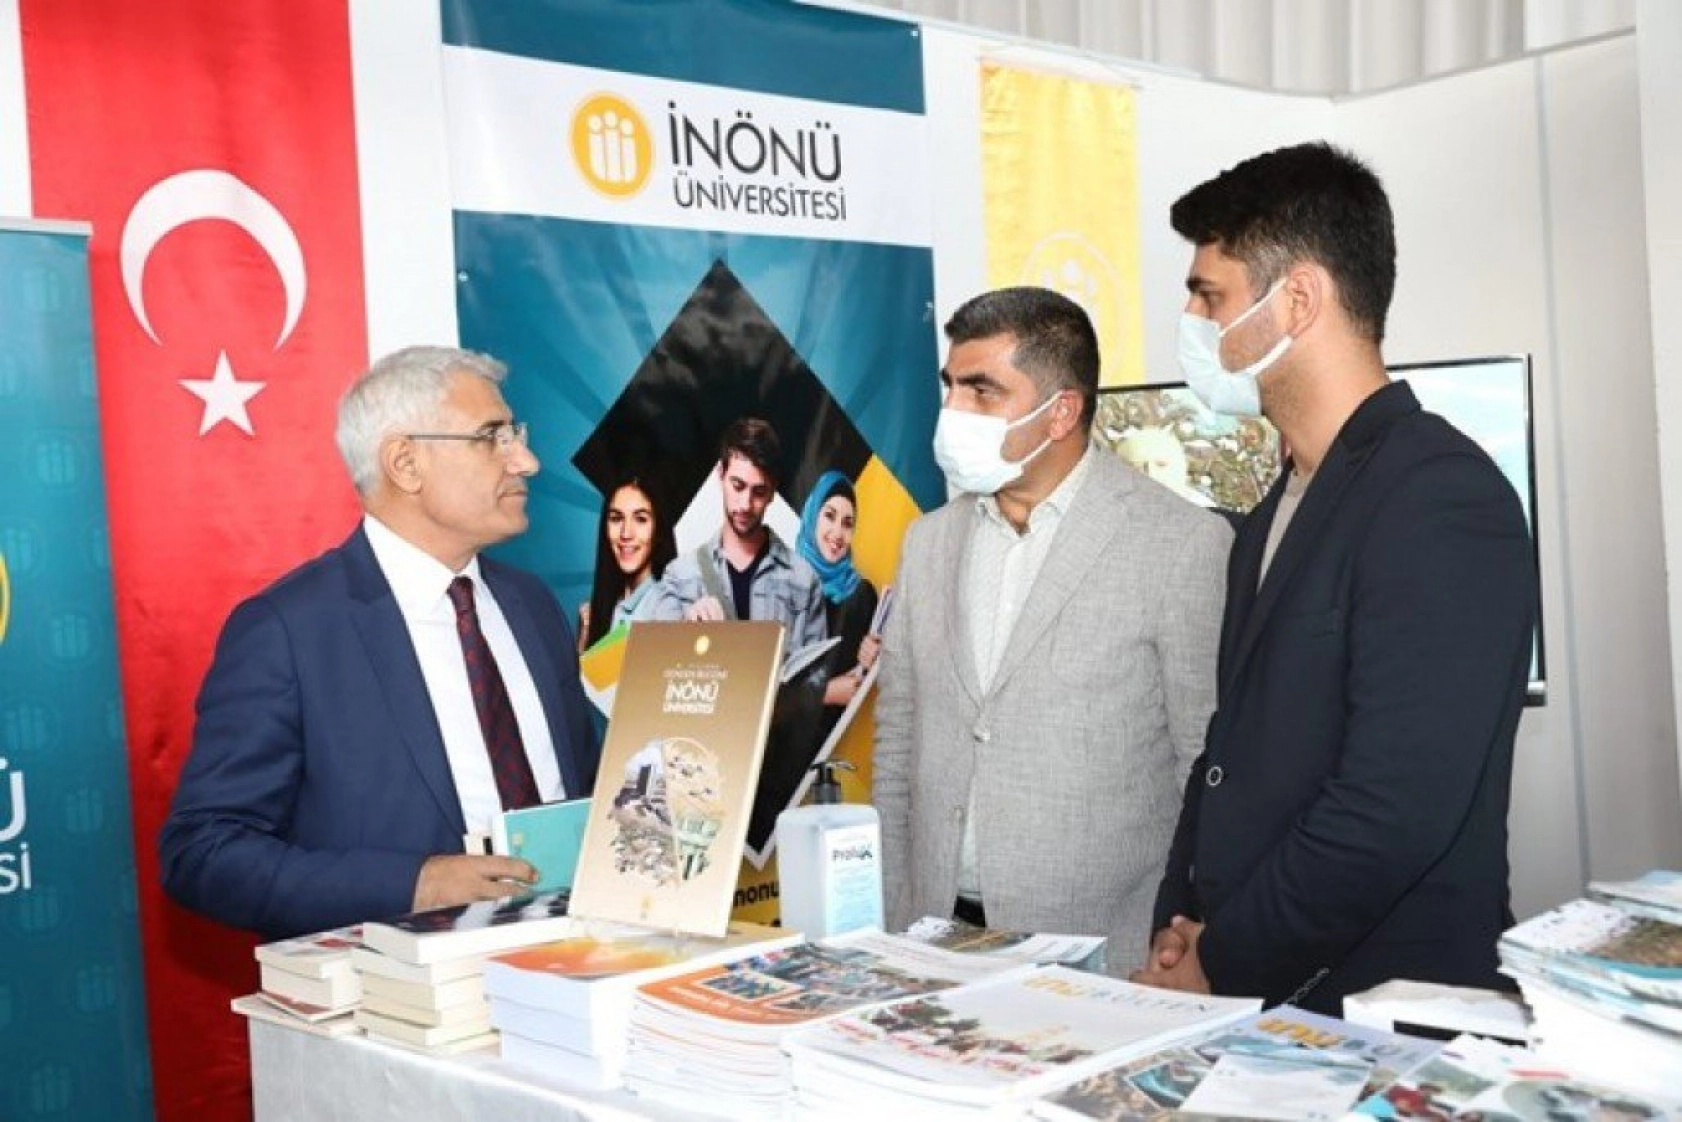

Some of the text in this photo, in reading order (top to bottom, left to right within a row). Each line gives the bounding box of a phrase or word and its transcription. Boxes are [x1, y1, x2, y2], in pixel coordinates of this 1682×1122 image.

[668, 100, 842, 182] İNÖNÜ
[673, 170, 847, 221] ÜNİVERSİTESİ
[665, 679, 719, 702] İNÖNÜ
